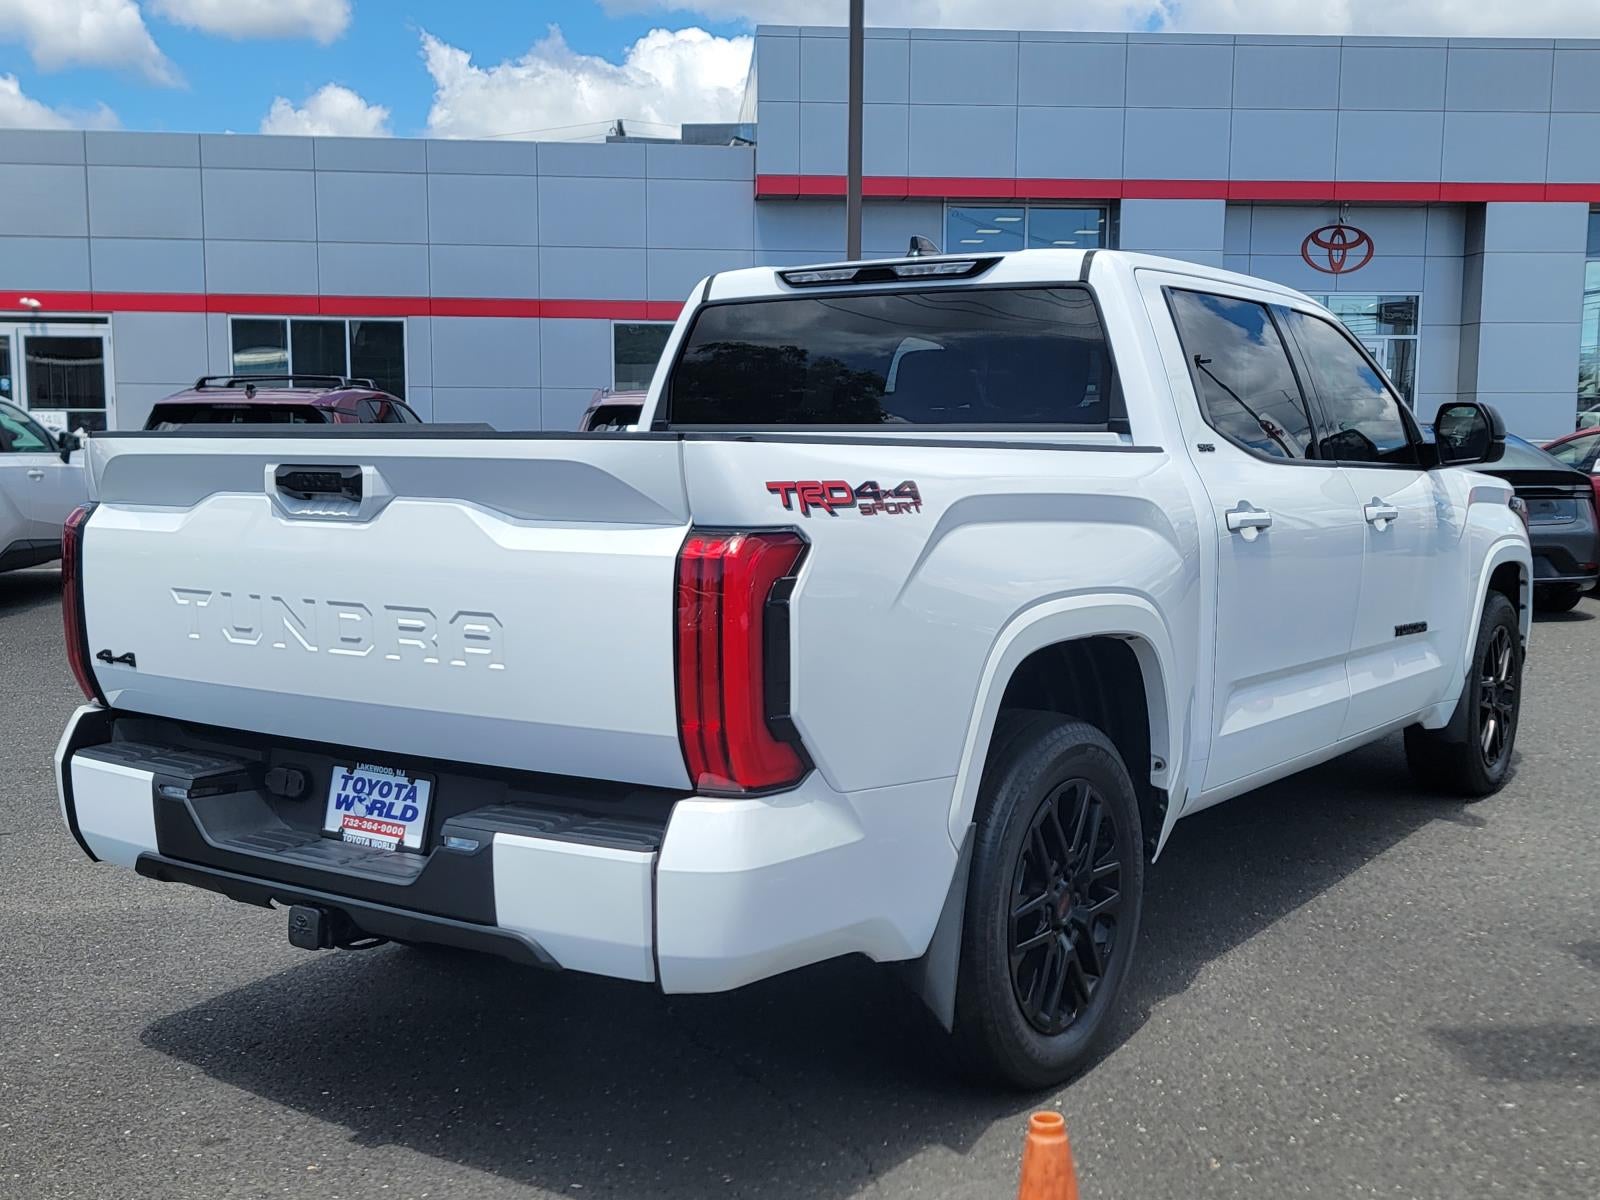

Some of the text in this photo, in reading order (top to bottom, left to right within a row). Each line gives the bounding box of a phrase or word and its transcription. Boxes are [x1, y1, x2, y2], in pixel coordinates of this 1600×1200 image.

[766, 480, 857, 518] TRD
[858, 501, 923, 516] SPORT
[170, 587, 505, 670] TUNDRA
[396, 768, 406, 777] NJ
[341, 774, 418, 803] TOYOTA
[343, 817, 404, 836] 732-364-9000
[343, 833, 396, 851] TOYOTA WORLD
